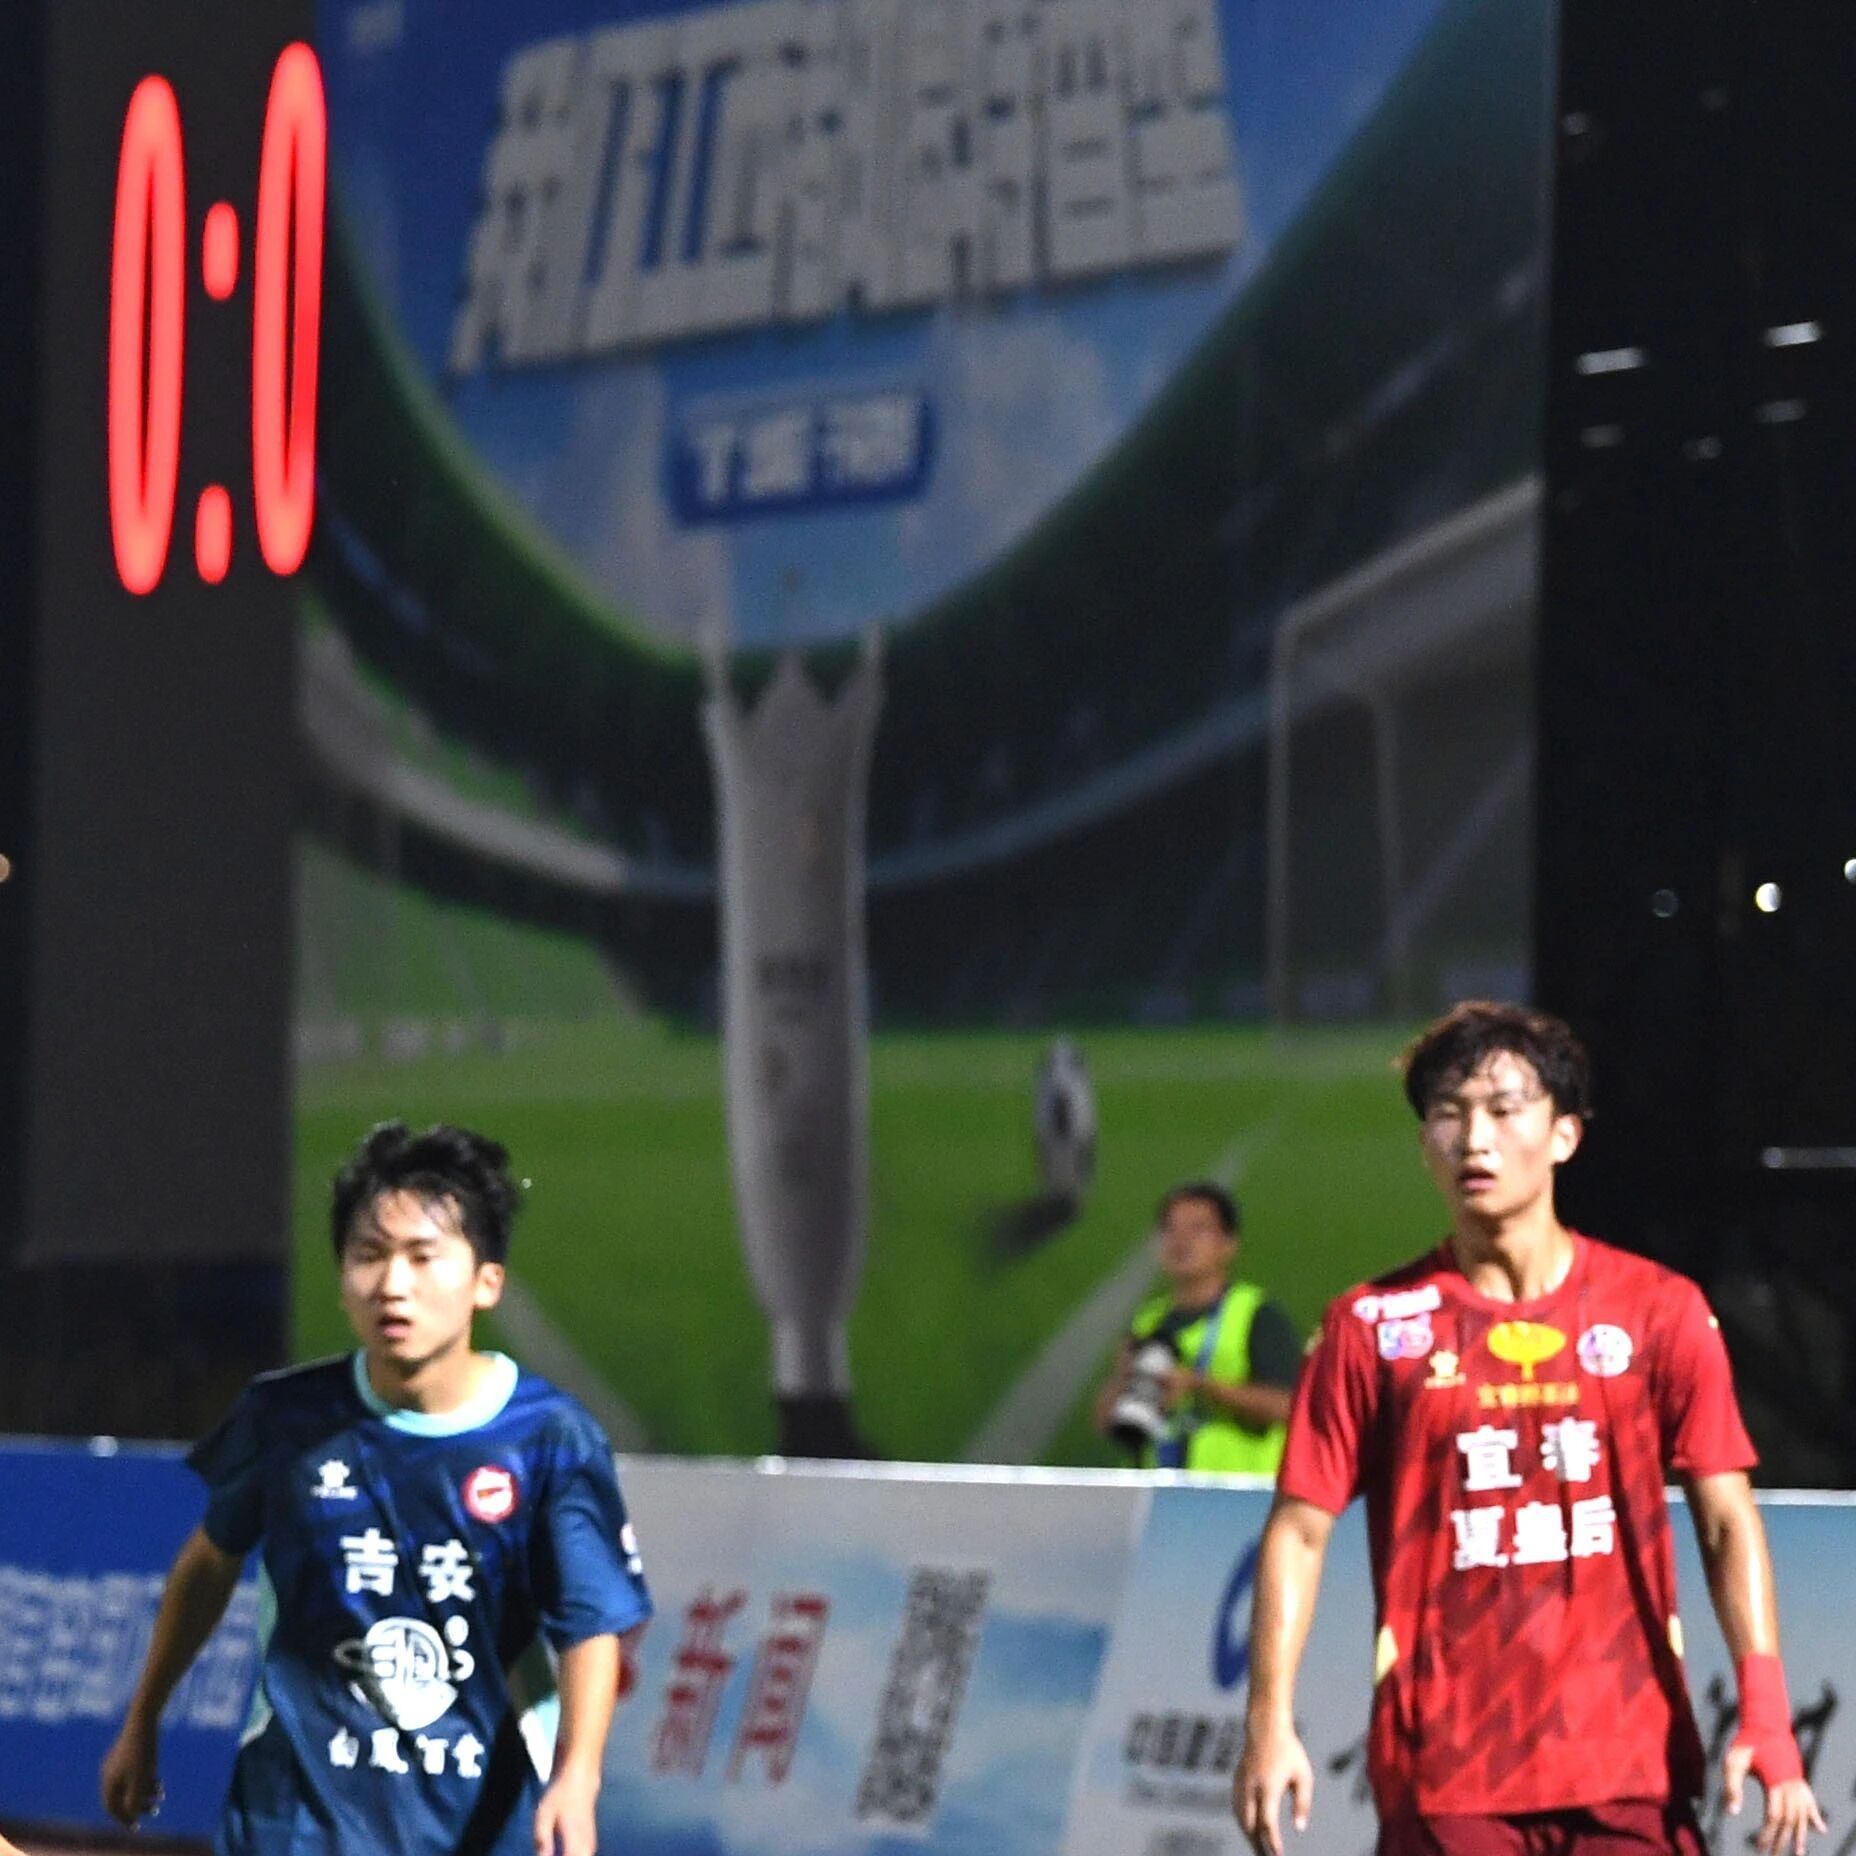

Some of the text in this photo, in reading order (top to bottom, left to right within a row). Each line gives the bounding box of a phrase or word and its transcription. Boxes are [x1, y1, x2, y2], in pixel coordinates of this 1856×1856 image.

[108, 41, 327, 595] 0:0
[1455, 1417, 1602, 1493] 宜春
[340, 1527, 477, 1603] 吉安
